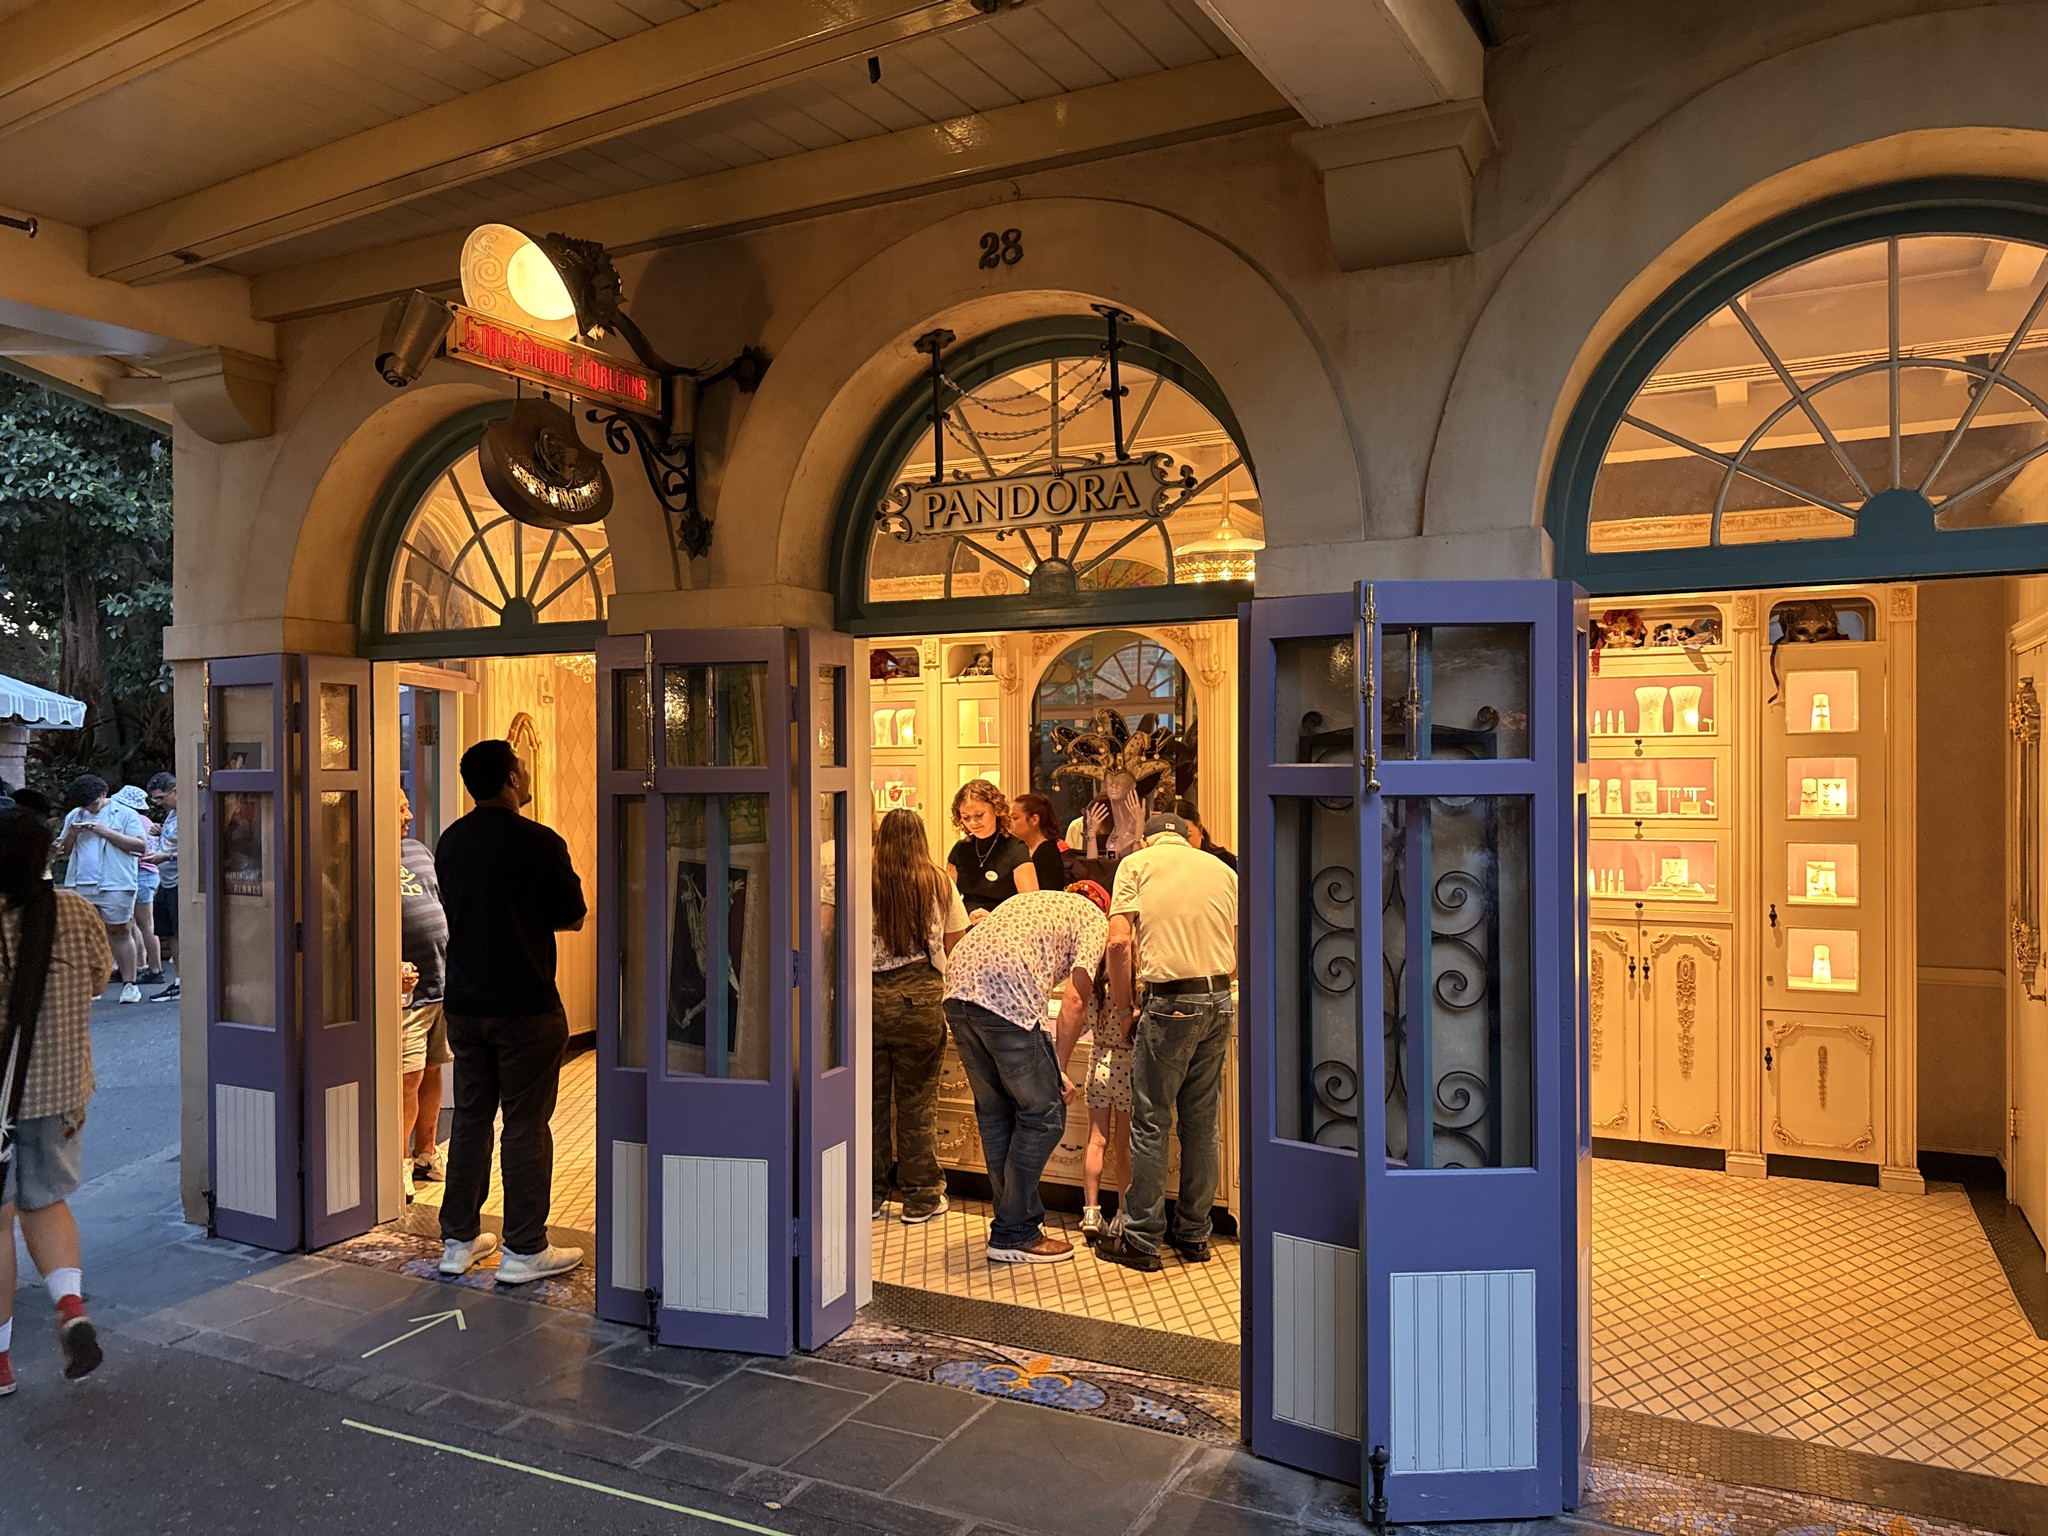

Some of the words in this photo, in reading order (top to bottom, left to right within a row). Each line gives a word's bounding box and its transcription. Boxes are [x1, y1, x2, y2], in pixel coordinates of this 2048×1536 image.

[978, 228, 1025, 269] 28
[459, 315, 481, 354] La
[481, 324, 574, 378] MASCARADE
[923, 470, 1141, 529] PANDORA
